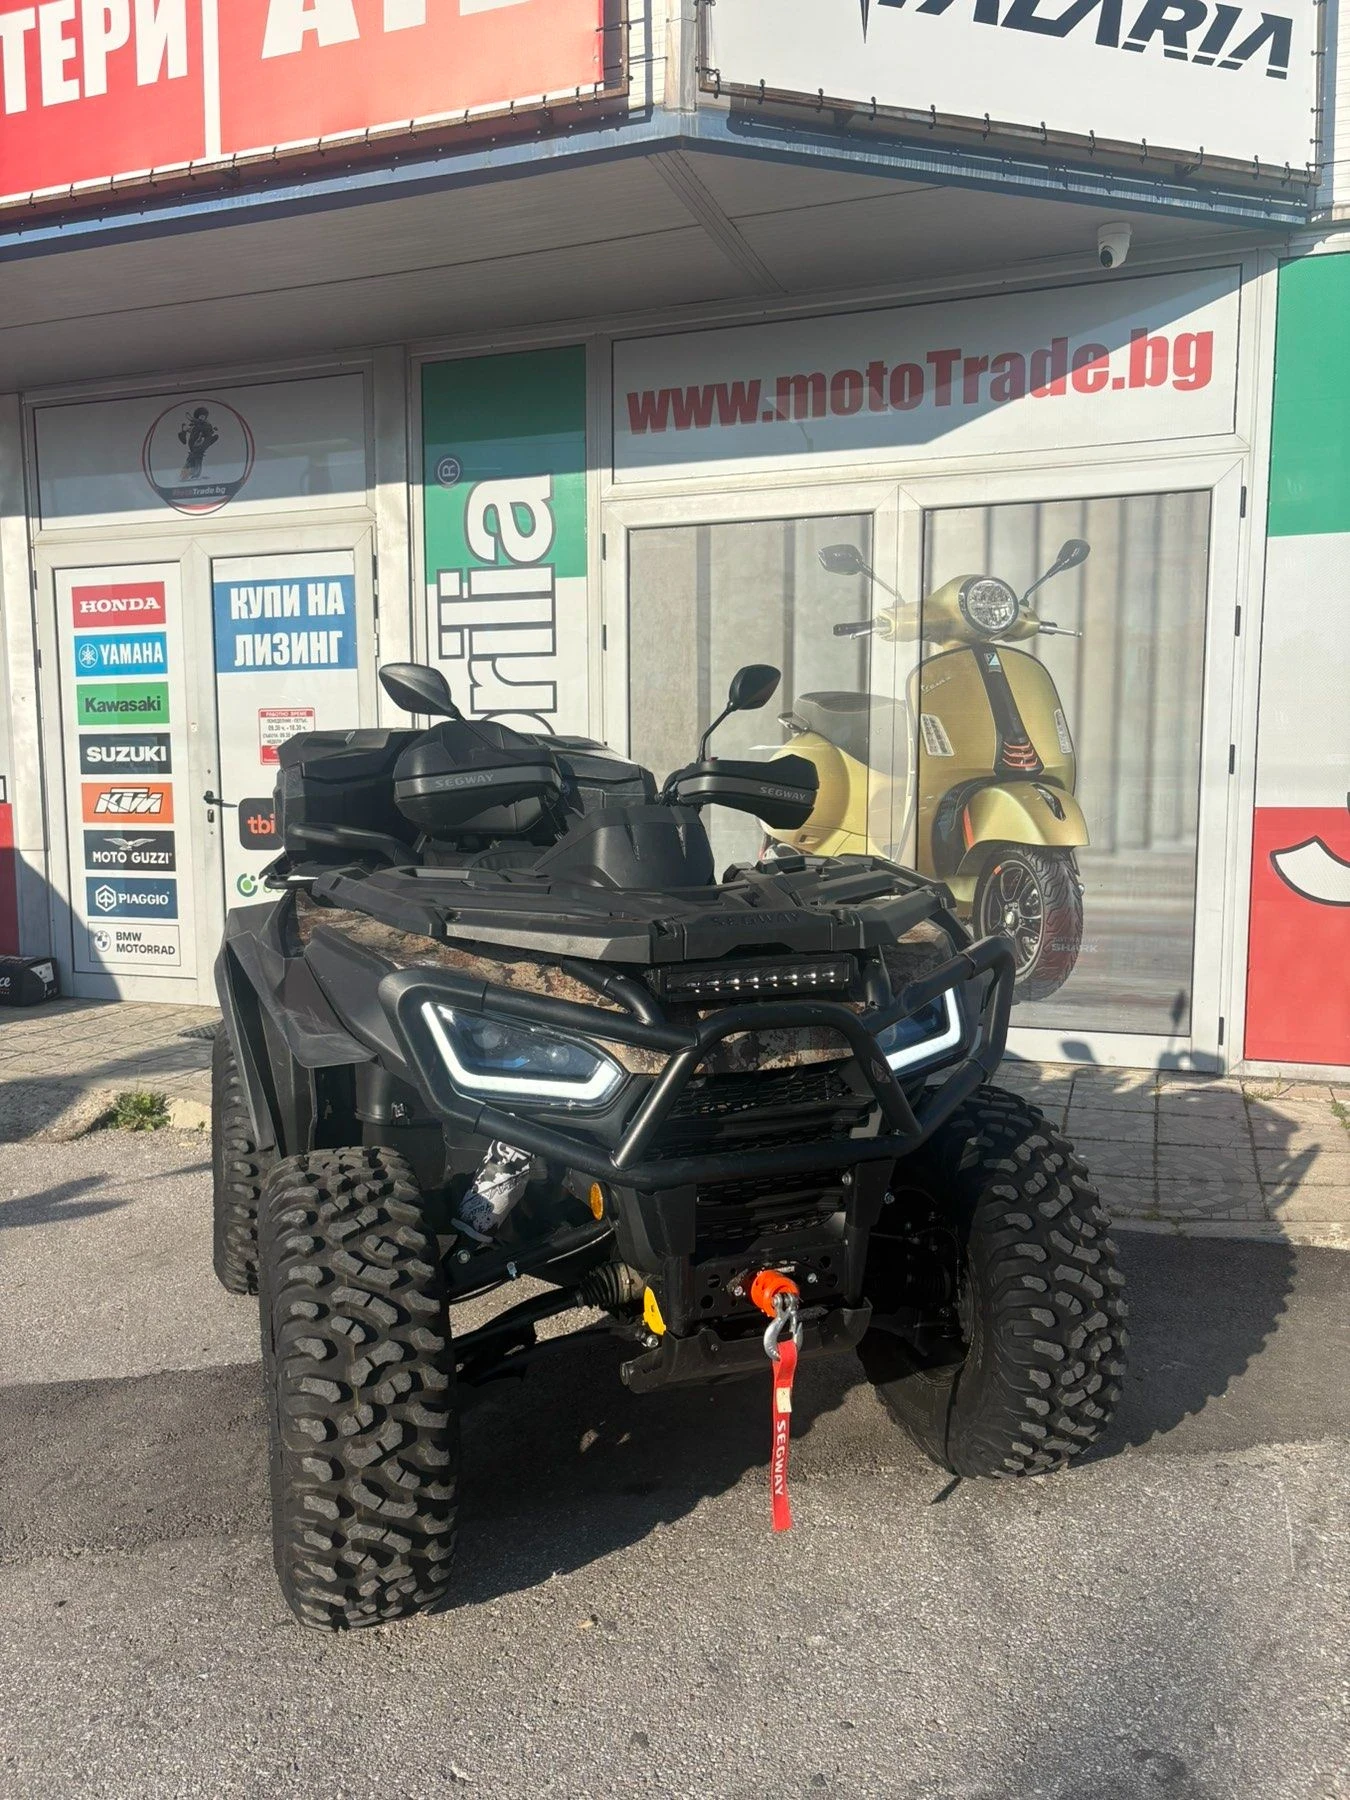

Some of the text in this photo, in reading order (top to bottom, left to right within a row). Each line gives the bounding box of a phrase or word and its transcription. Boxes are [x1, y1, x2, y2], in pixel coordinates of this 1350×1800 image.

[626, 328, 1214, 435] www.motoTrade.bg
[80, 597, 160, 613] HONDA
[230, 582, 346, 620] КУПИ НА
[100, 642, 163, 665] YAMAHA
[234, 630, 343, 667] ЛИЗИНГ
[85, 696, 161, 713] Kawasaki
[87, 746, 167, 762] SUZUKI
[435, 773, 494, 789] SEGWAY
[94, 787, 163, 814] KTM
[759, 786, 807, 801] SEGWAY
[247, 813, 275, 834] tbi
[92, 851, 169, 864] MOTO GUZZI
[118, 893, 169, 905] PIAGGIO
[116, 932, 142, 942] BMW
[116, 944, 176, 955] MOTORRAD
[774, 1419, 787, 1496] SEGWAY
